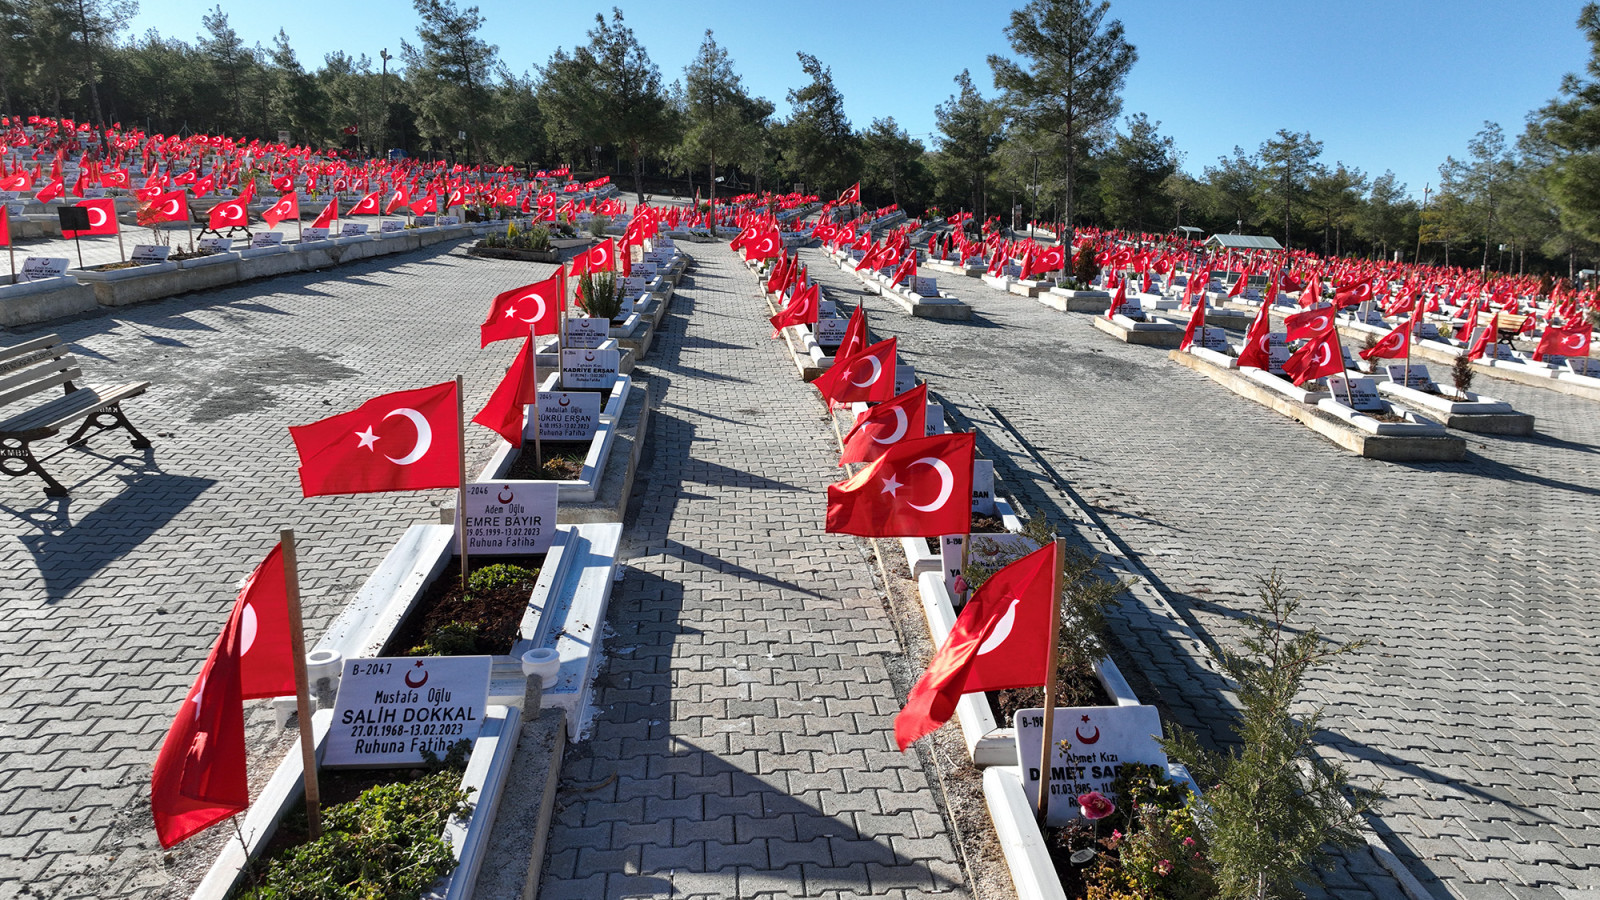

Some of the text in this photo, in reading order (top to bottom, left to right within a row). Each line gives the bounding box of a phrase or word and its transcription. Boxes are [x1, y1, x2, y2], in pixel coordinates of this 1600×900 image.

[565, 415, 591, 423] ERŞAN
[485, 503, 524, 516] Adem Oğlu
[466, 516, 541, 527] EMRE BAYIR
[470, 537, 535, 547] Ruhuna Fatiha
[353, 663, 392, 675] B-2047
[374, 688, 452, 706] Mustafa Oğlu
[342, 706, 476, 725] SALİH DOKKAL
[351, 724, 463, 737] 27.01.1968-13.02.2023
[355, 738, 454, 754] Ruhuna Fatiha
[1066, 751, 1118, 763] Ahmet Kızı
[1029, 766, 1086, 781] DMET
